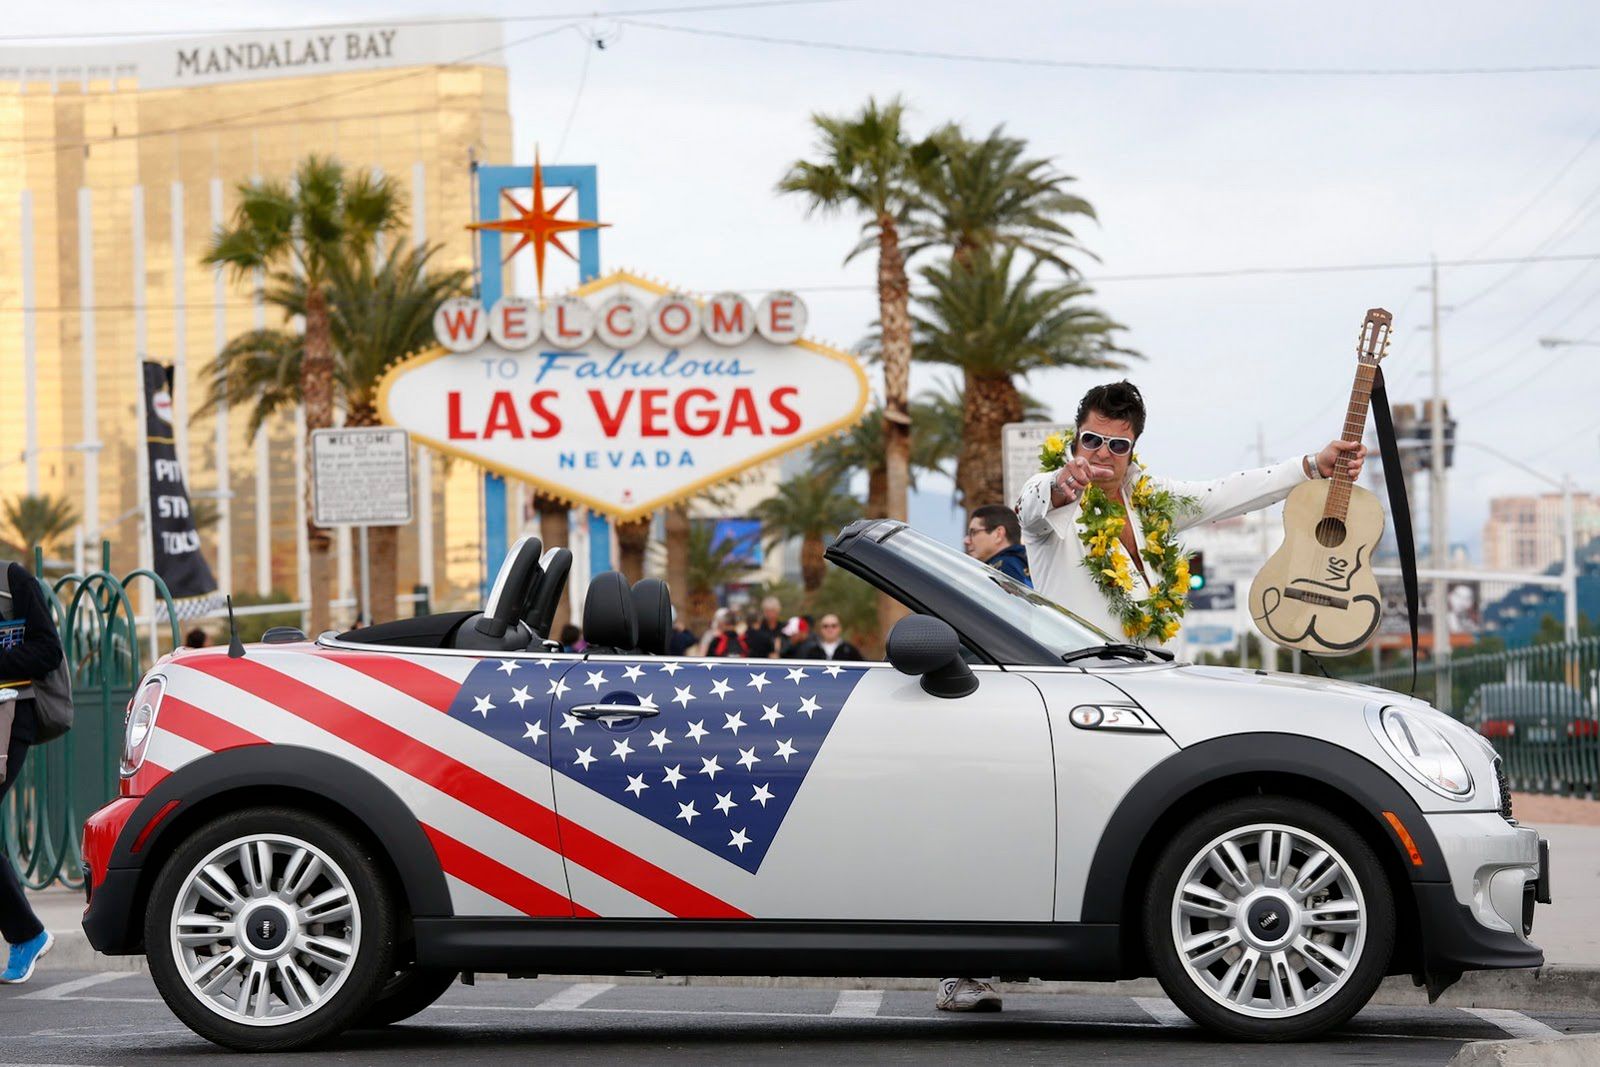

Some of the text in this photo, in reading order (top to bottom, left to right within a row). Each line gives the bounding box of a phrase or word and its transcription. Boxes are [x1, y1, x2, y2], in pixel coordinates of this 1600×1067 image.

[177, 29, 396, 76] MANDALAY BAY
[442, 300, 794, 342] WELCOME
[482, 349, 755, 384] TO Fabulous
[447, 386, 803, 440] LAS VEGAS
[559, 450, 695, 470] NEVADA
[262, 920, 271, 938] MINI
[1260, 912, 1278, 928] MINI
